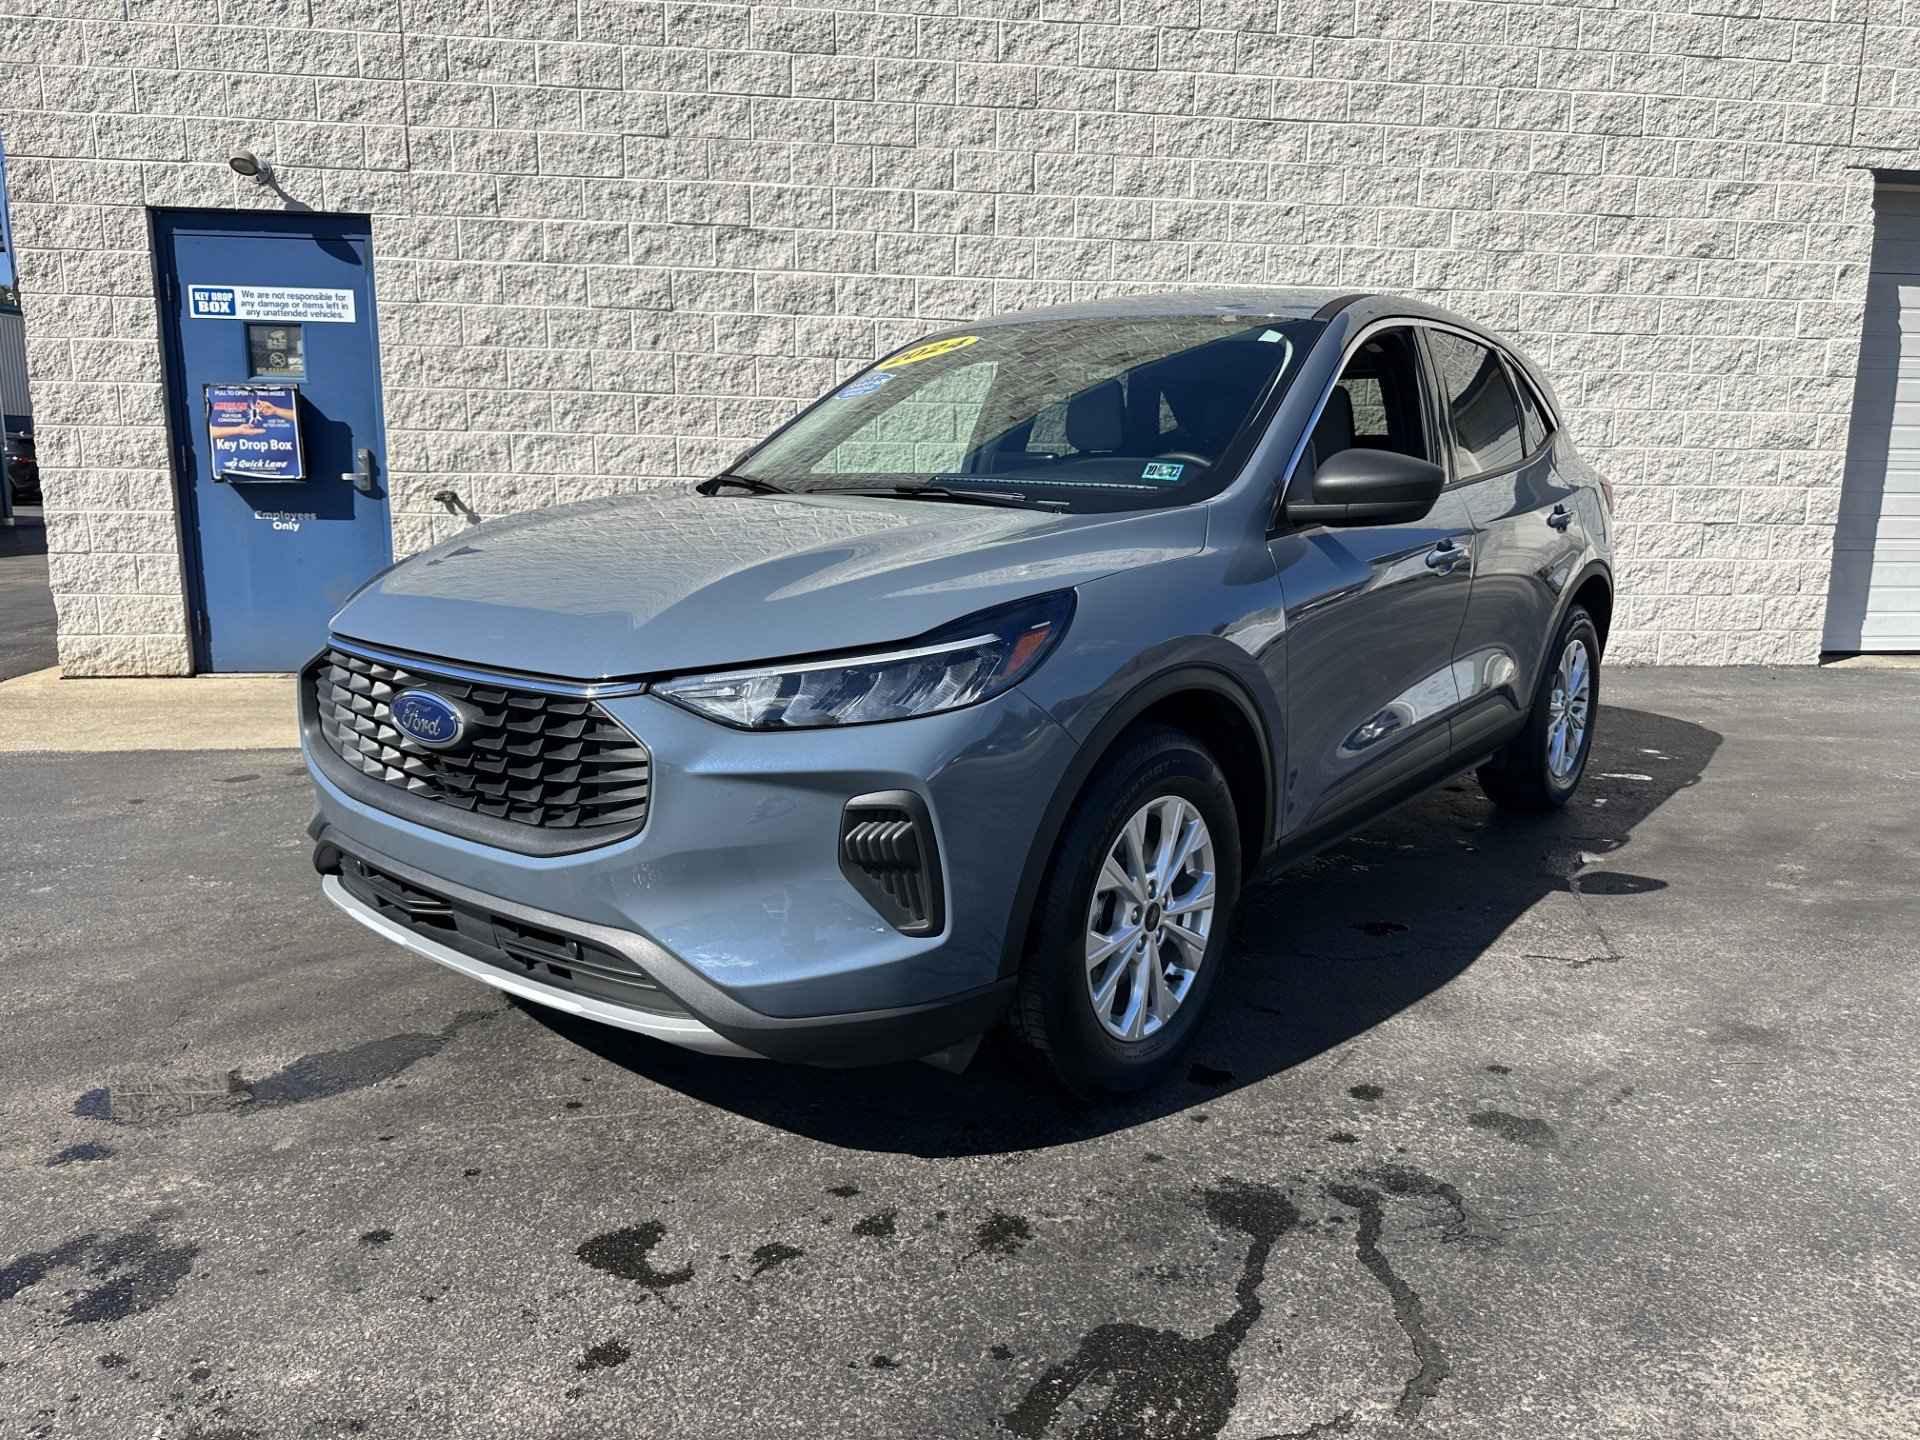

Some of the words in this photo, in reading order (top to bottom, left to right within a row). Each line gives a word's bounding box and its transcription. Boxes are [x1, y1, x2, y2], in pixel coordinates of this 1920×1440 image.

[195, 291, 210, 301] KEY
[211, 292, 233, 302] DROP
[241, 290, 255, 299] We
[272, 291, 285, 300] not
[287, 292, 332, 302] responsible
[335, 292, 346, 301] for
[198, 301, 231, 313] BOX
[258, 300, 290, 310] damage
[302, 302, 324, 310] items
[326, 302, 340, 310] left
[246, 310, 260, 318] any
[263, 308, 307, 318] unattended
[309, 310, 344, 319] vehicles.
[216, 438, 237, 452] Key
[239, 438, 268, 453] Drop
[270, 439, 293, 450] Box
[238, 459, 264, 468] Quick
[264, 460, 288, 468] Lane
[254, 510, 317, 521] Employees
[272, 521, 300, 531] Only
[401, 702, 441, 736] Ford
